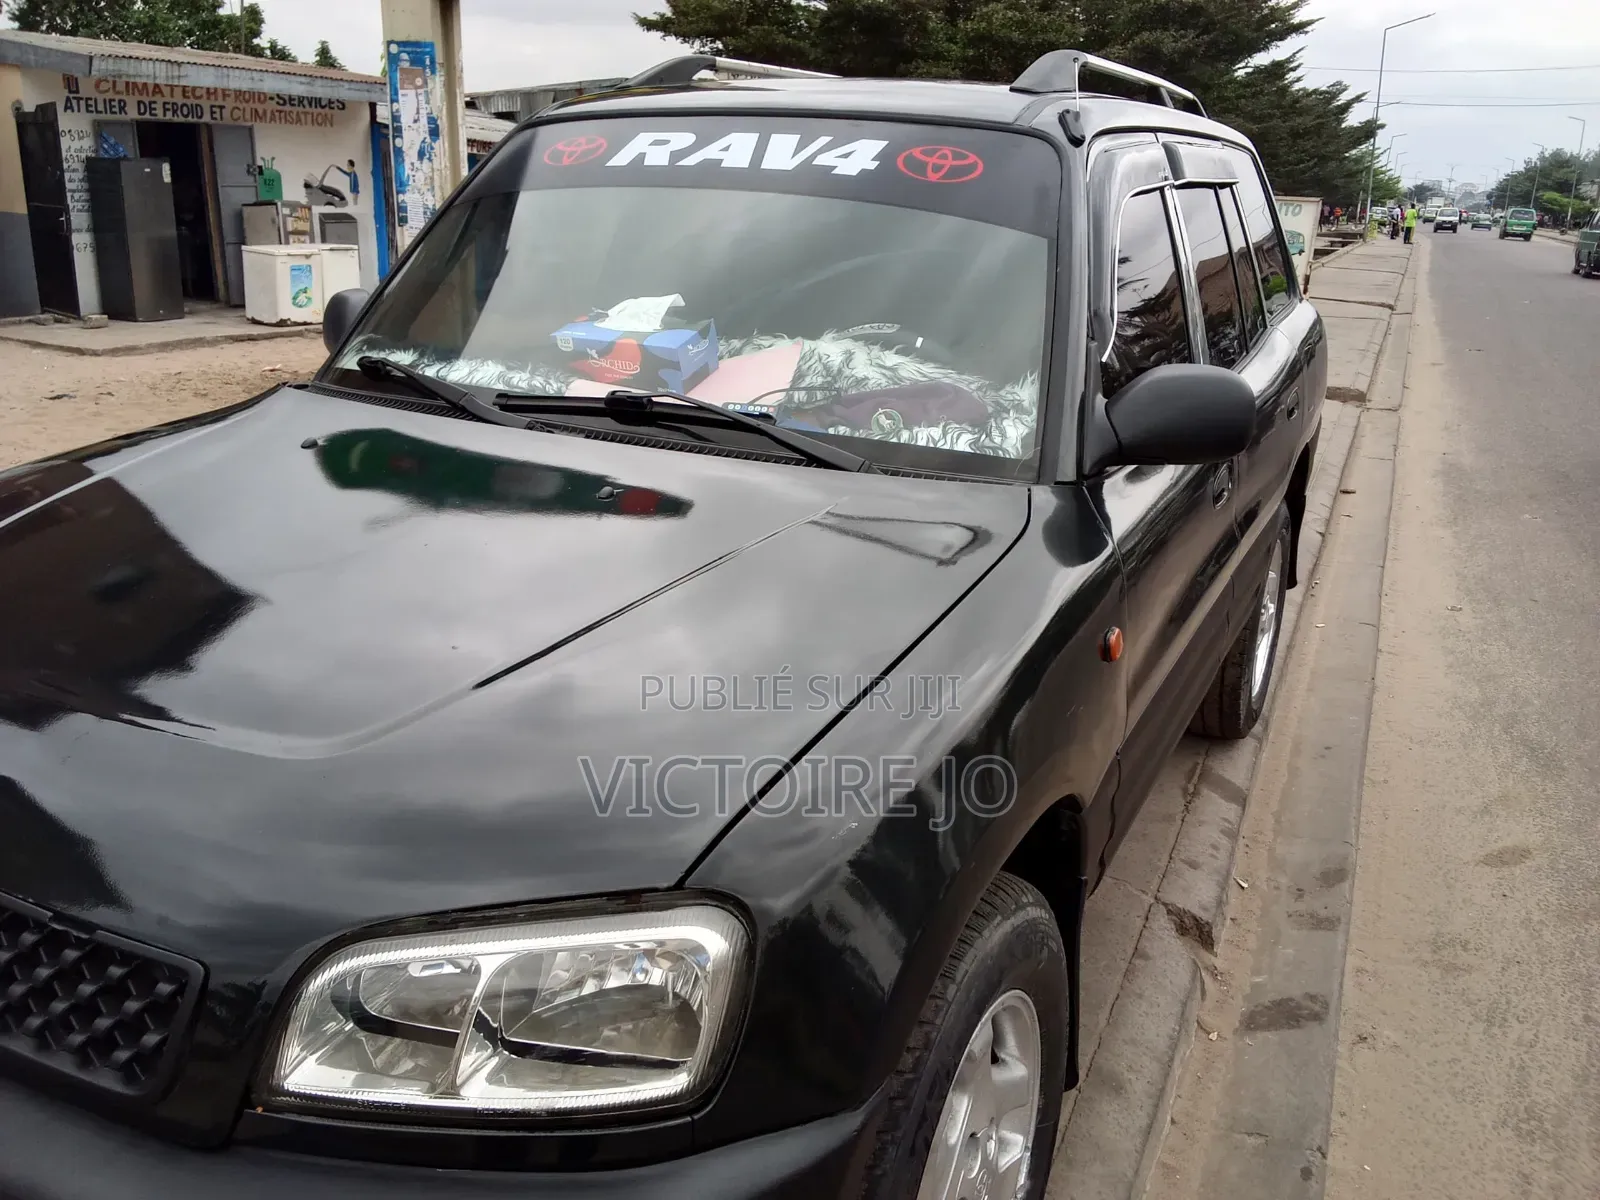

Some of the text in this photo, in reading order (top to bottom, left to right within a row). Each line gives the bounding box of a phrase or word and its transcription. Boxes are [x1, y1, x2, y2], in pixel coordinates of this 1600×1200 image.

[63, 96, 335, 127] ATELIER DE FROID ET CLIMATISATION
[605, 132, 889, 176] RAV4
